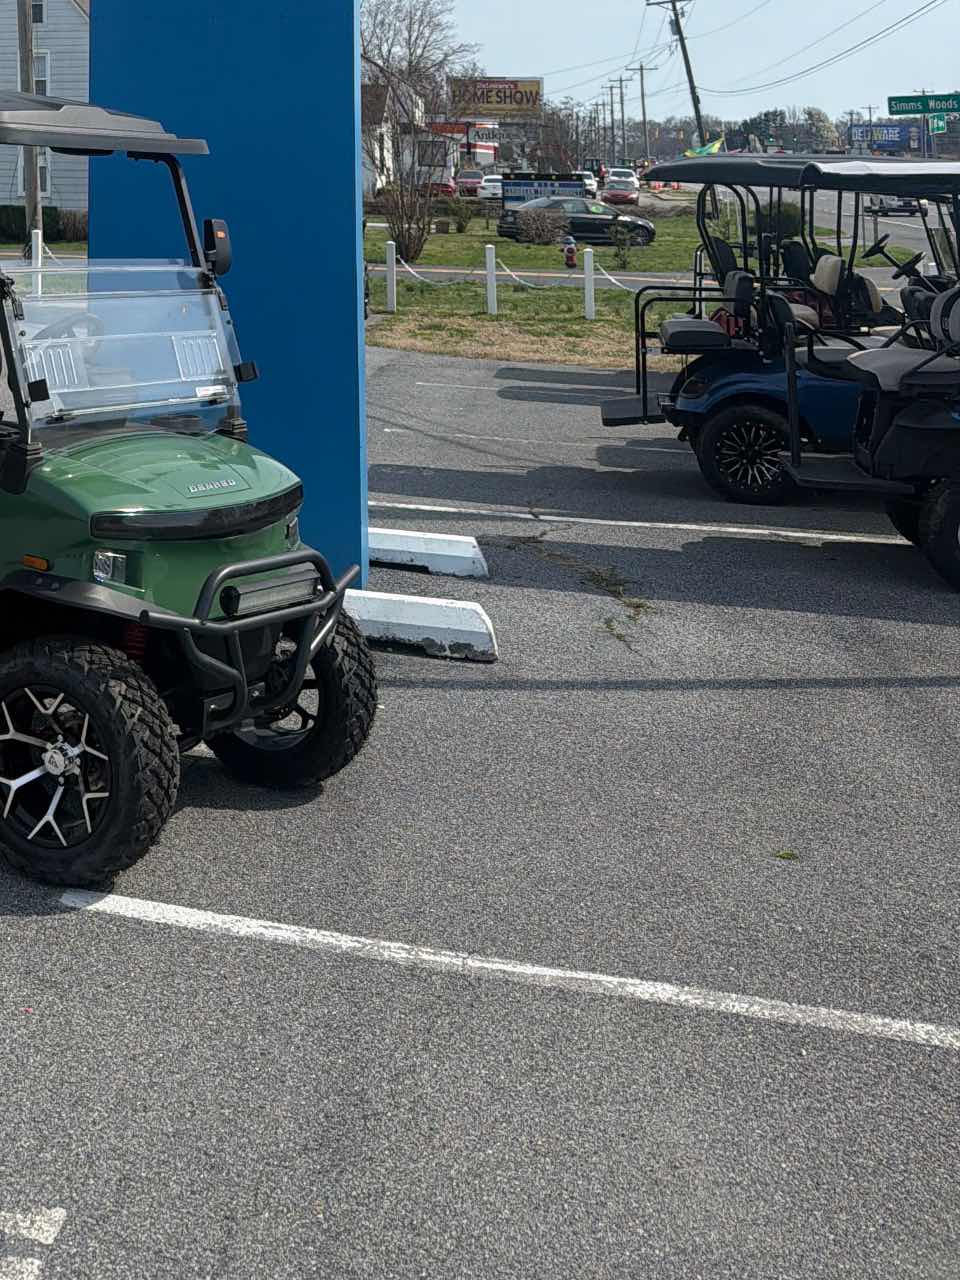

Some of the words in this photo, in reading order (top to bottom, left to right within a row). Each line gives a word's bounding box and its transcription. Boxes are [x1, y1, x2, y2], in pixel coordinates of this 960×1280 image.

[496, 88, 540, 106] SHOW
[890, 101, 923, 111] Simms
[927, 99, 958, 110] Woods
